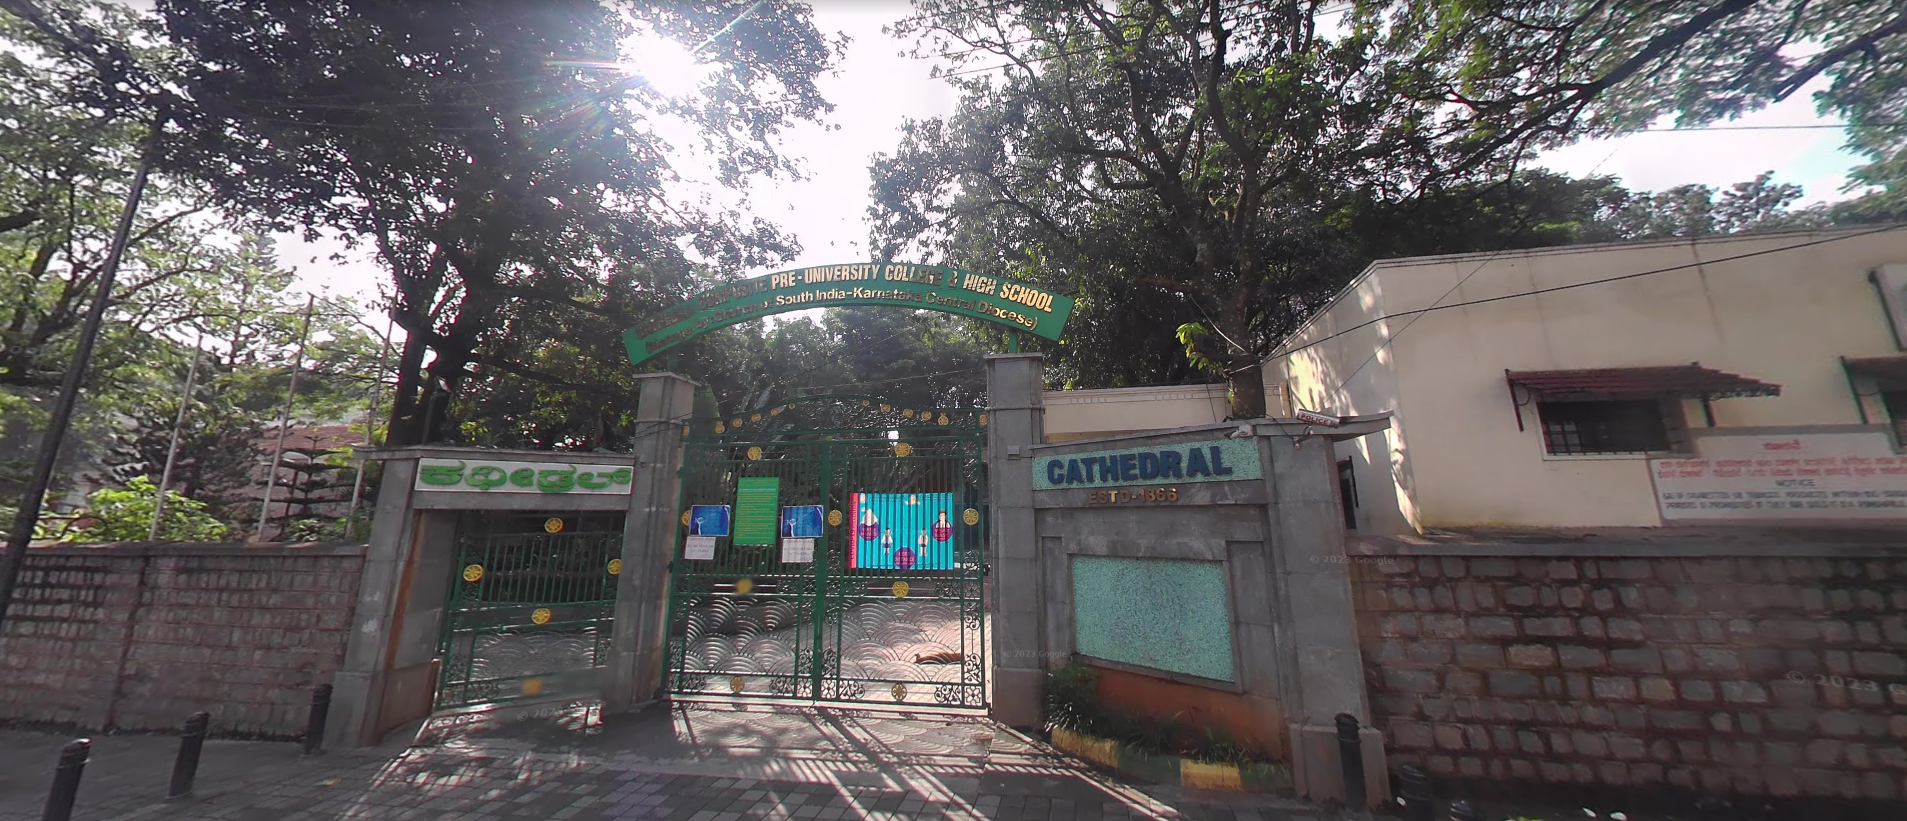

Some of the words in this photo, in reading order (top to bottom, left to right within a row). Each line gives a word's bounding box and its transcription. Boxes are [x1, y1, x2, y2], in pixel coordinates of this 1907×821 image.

[884, 265, 943, 286] COLLEGE
[947, 271, 958, 287] &
[963, 273, 997, 295] HIGH
[999, 282, 1053, 313] SCHOOL
[776, 290, 814, 306] South
[925, 292, 975, 312] Central
[976, 301, 1038, 330] Diocese)
[1301, 413, 1330, 425] POLICE
[1046, 446, 1233, 485] CATHEDRAL
[1775, 478, 1817, 488] NOTICE
